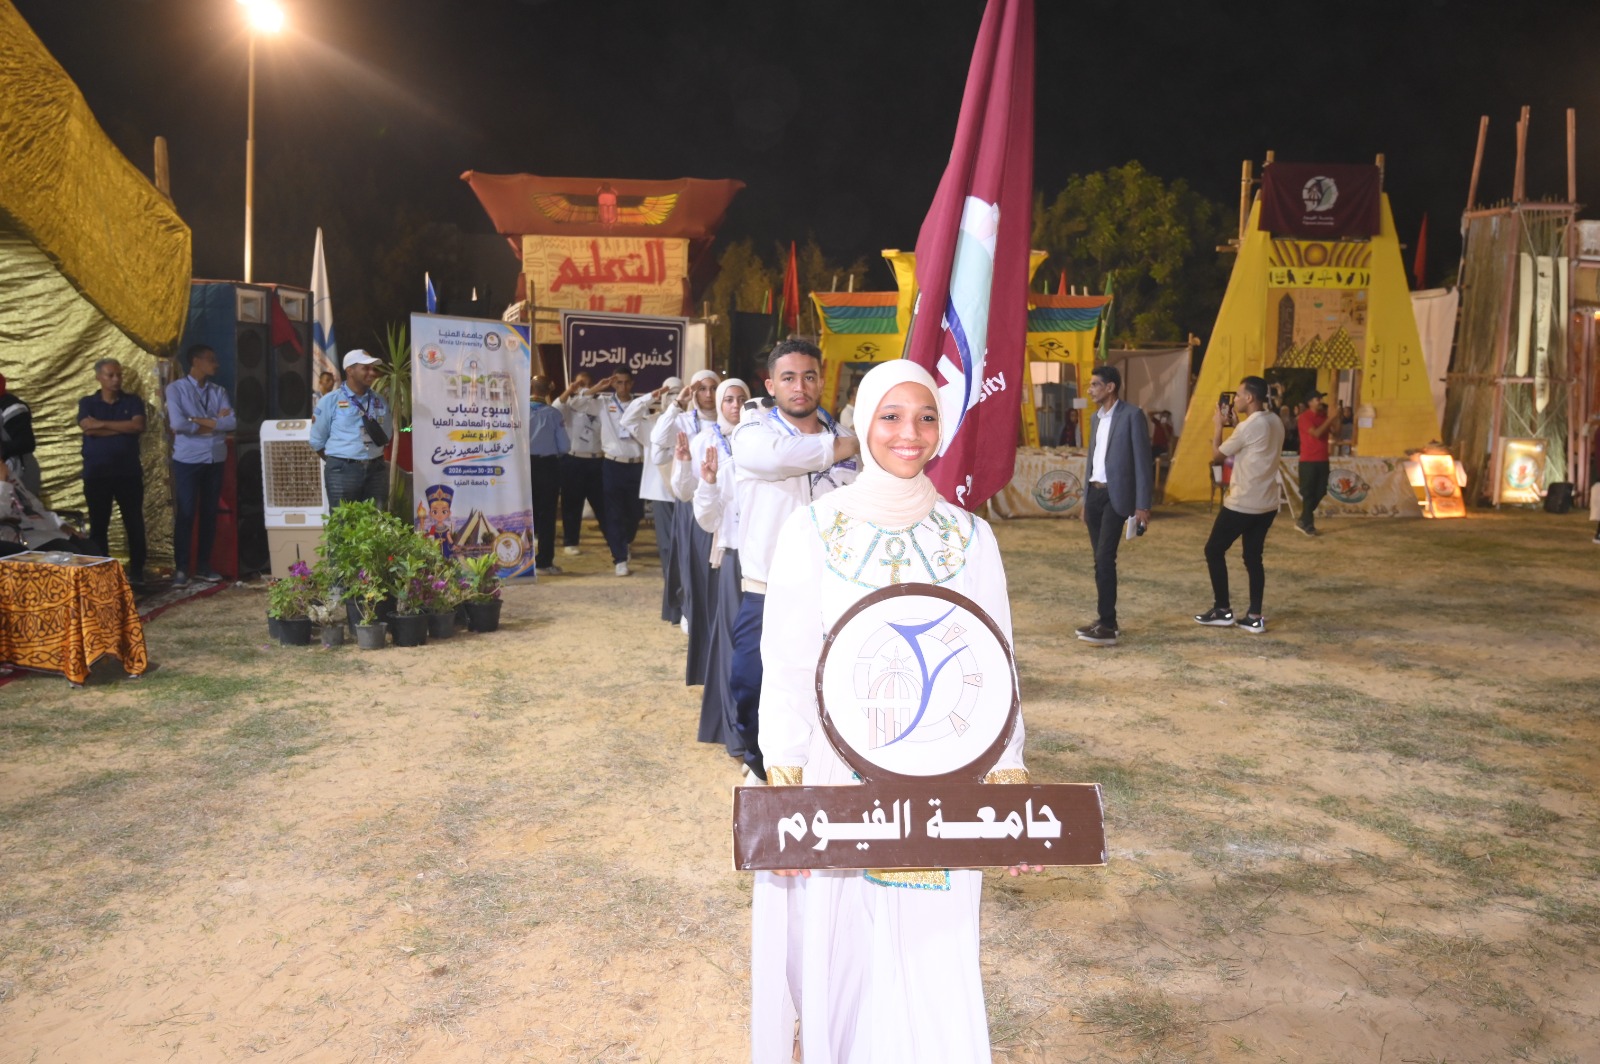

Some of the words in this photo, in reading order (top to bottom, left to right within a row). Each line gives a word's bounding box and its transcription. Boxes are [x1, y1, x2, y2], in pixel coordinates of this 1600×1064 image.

[550, 239, 666, 293] التعليم
[438, 329, 460, 338] المنيا
[461, 331, 483, 339] جامعة
[455, 340, 483, 348] University
[580, 347, 626, 367] التحرير
[629, 348, 673, 374] كشري
[447, 402, 479, 416] شباب
[432, 418, 453, 428] العليا
[455, 418, 491, 429] والمعاهد
[492, 420, 522, 431] الجامعات
[460, 430, 477, 439] عشر
[478, 431, 497, 441] الرابع
[457, 444, 483, 458] الصعيد
[484, 442, 501, 456] قلب
[502, 443, 514, 453] من
[454, 479, 470, 487] المنيا
[470, 479, 488, 487] جامعة
[777, 798, 911, 853] الفيوم
[926, 798, 1062, 849] جامعة
